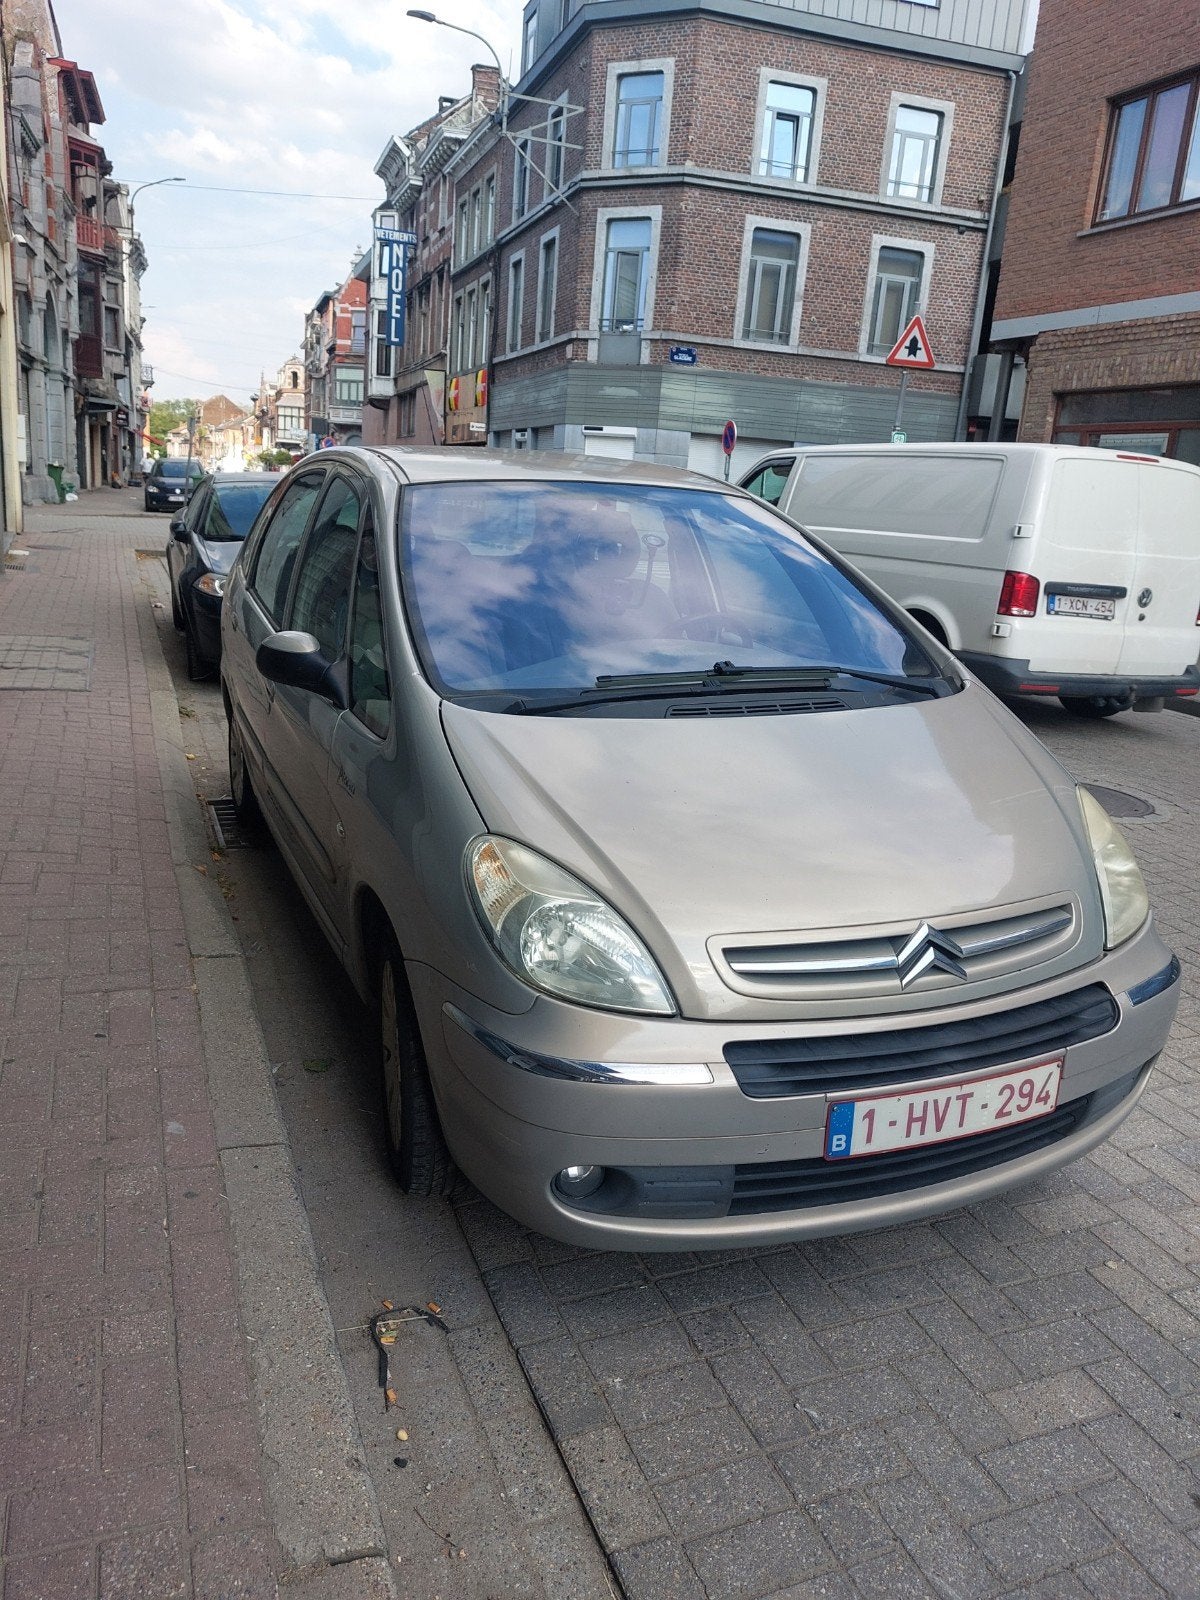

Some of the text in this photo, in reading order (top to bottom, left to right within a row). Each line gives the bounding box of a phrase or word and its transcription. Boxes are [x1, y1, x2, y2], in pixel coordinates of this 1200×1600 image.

[391, 243, 403, 341] NOEL
[1057, 597, 1113, 613] 1-XCN-454
[862, 1071, 1053, 1145] 1-HVT-294
[832, 1134, 846, 1152] B
